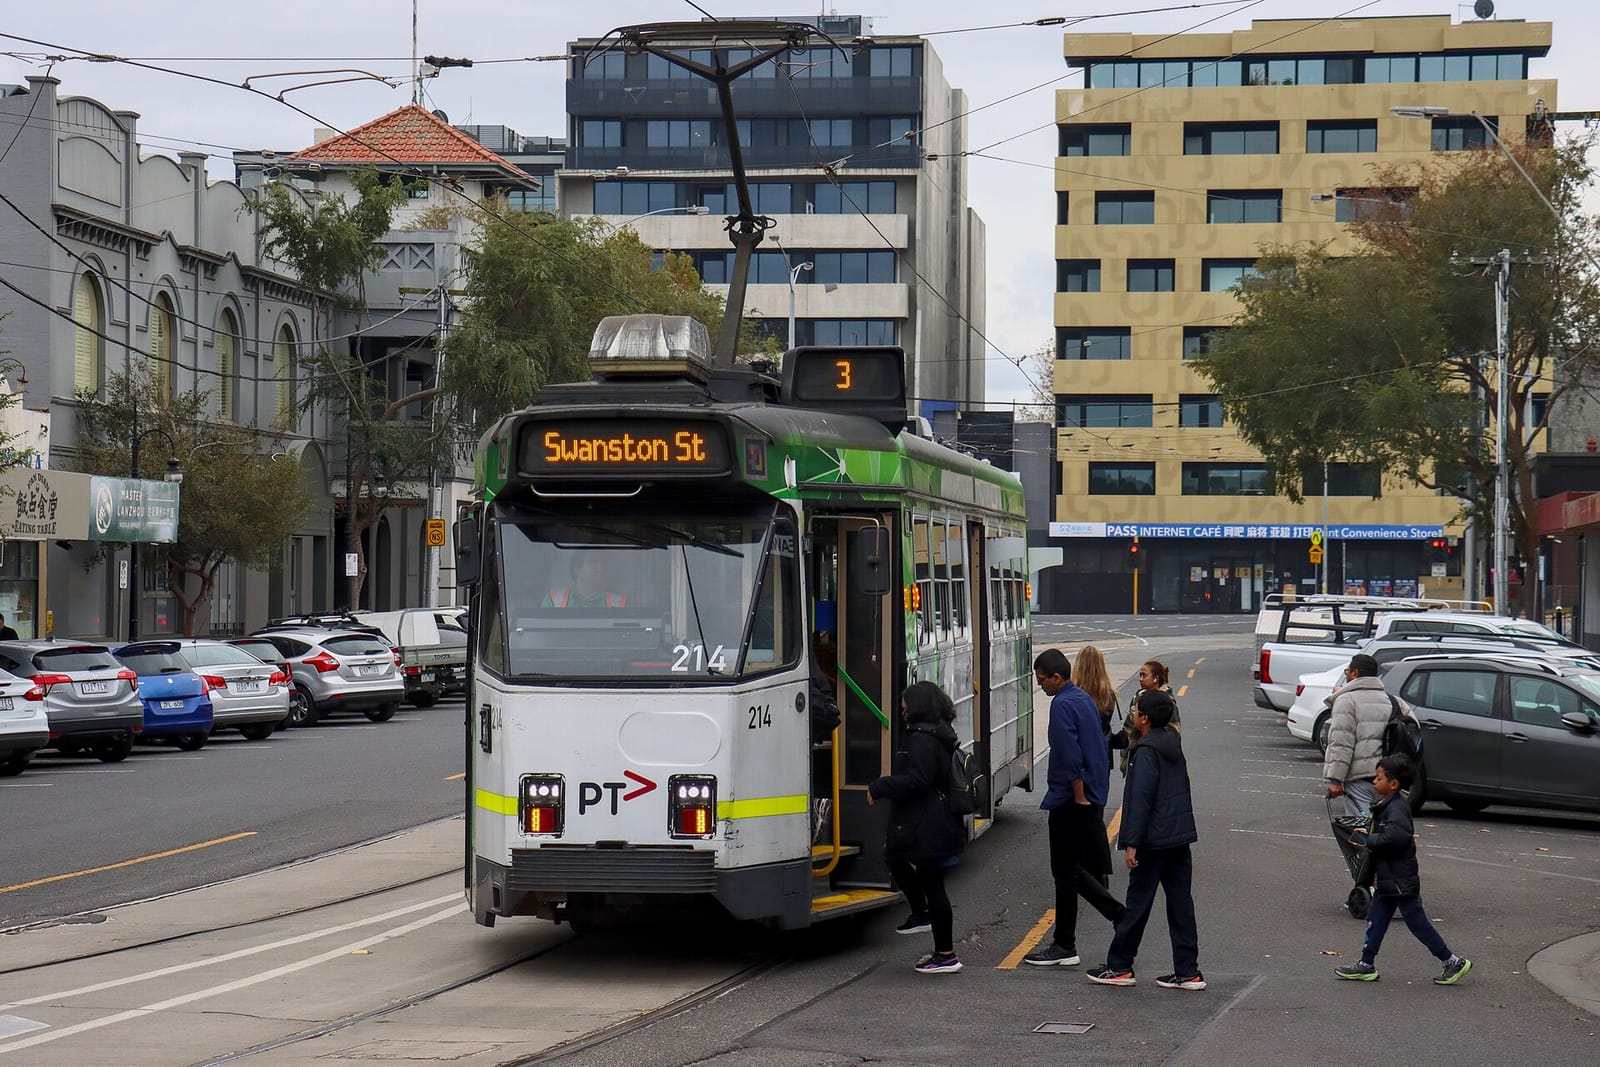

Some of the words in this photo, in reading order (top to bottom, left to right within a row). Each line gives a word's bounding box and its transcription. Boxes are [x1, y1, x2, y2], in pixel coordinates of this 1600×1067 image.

[834, 360, 851, 390] 3
[544, 432, 669, 462] Swanston
[675, 431, 706, 462] St
[117, 505, 145, 517] LANZHOU
[15, 520, 36, 534] EATING
[37, 522, 57, 535] TABLE
[1107, 525, 1137, 537] PASS
[1140, 527, 1192, 537] INTERNET
[1193, 525, 1221, 537] CAFÉ
[1341, 528, 1408, 538] Convenience
[1410, 528, 1438, 538] Store
[671, 644, 726, 672] 214
[748, 704, 771, 730] 214
